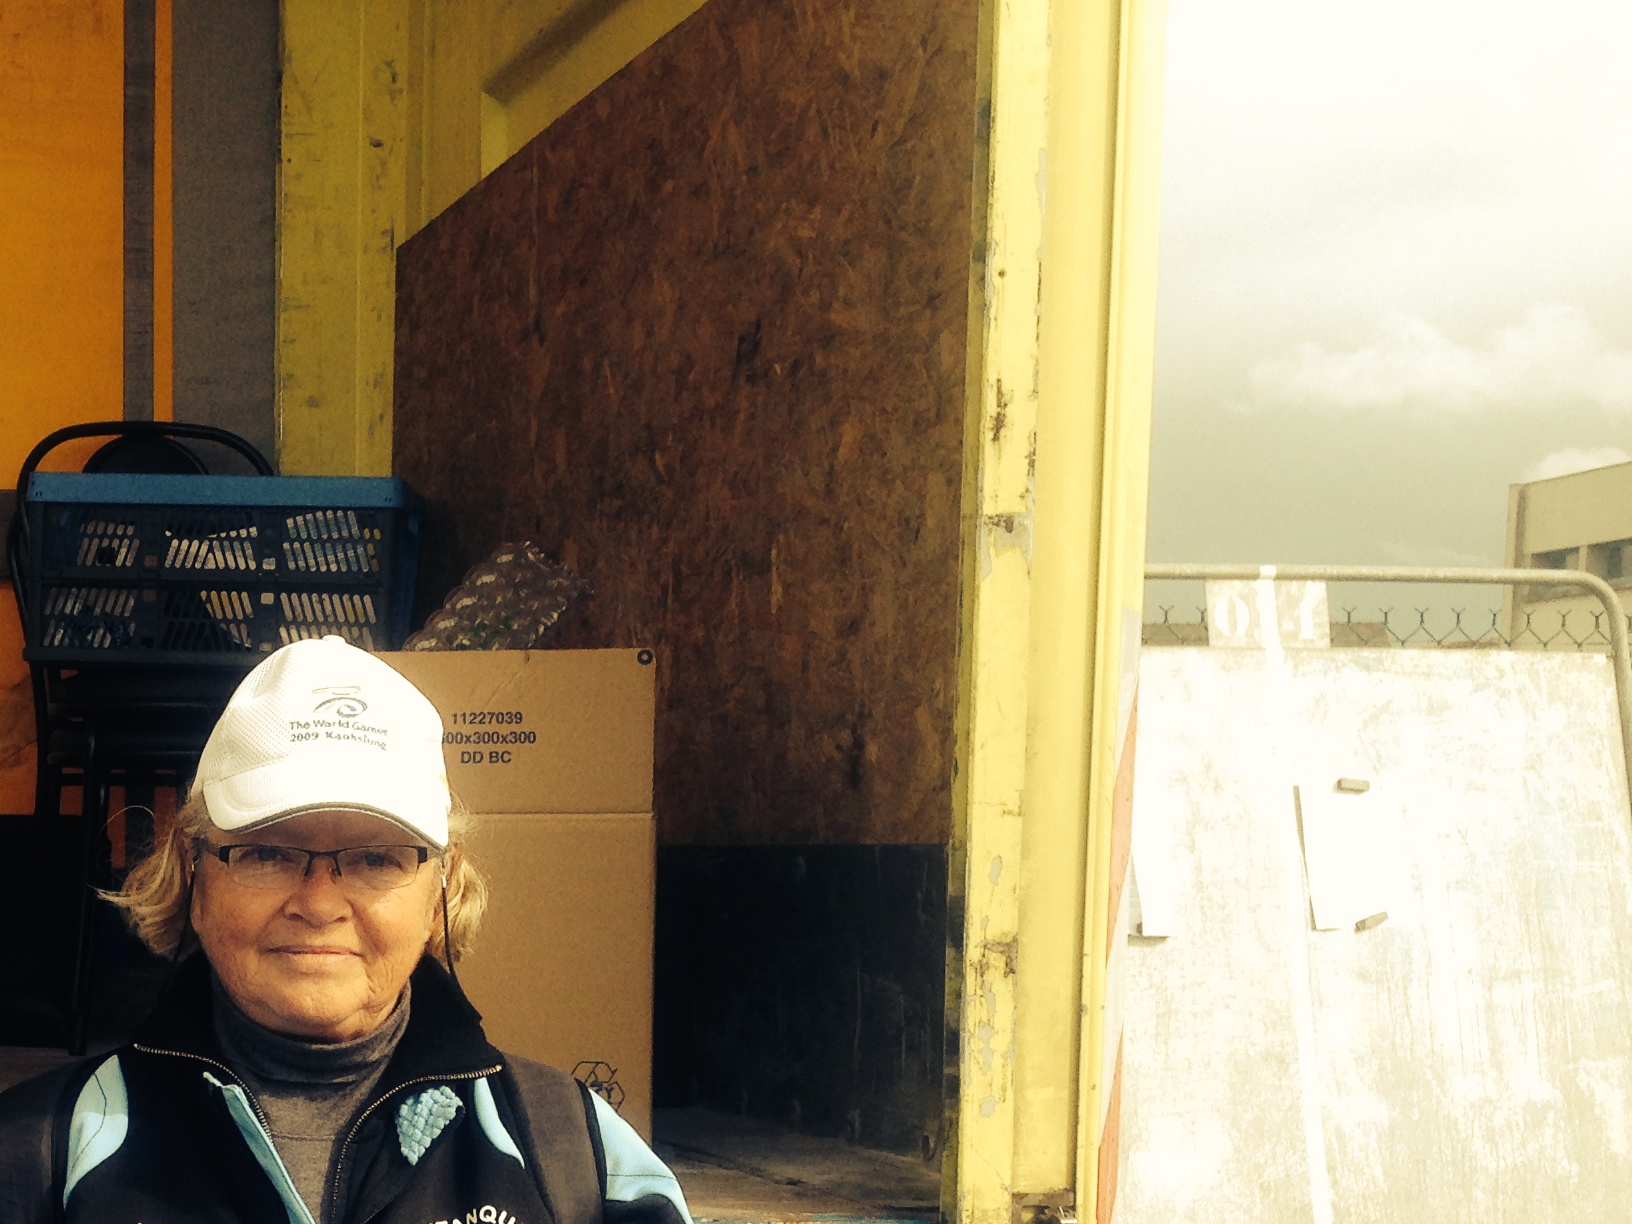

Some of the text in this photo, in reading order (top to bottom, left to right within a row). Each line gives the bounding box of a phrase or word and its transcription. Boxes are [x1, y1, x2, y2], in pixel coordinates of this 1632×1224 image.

[289, 720, 311, 730] The
[312, 719, 350, 729] World
[451, 711, 523, 725] 11227039
[289, 732, 320, 743] 2009
[442, 731, 537, 745] 00x300x300
[460, 751, 512, 764] DD BC
